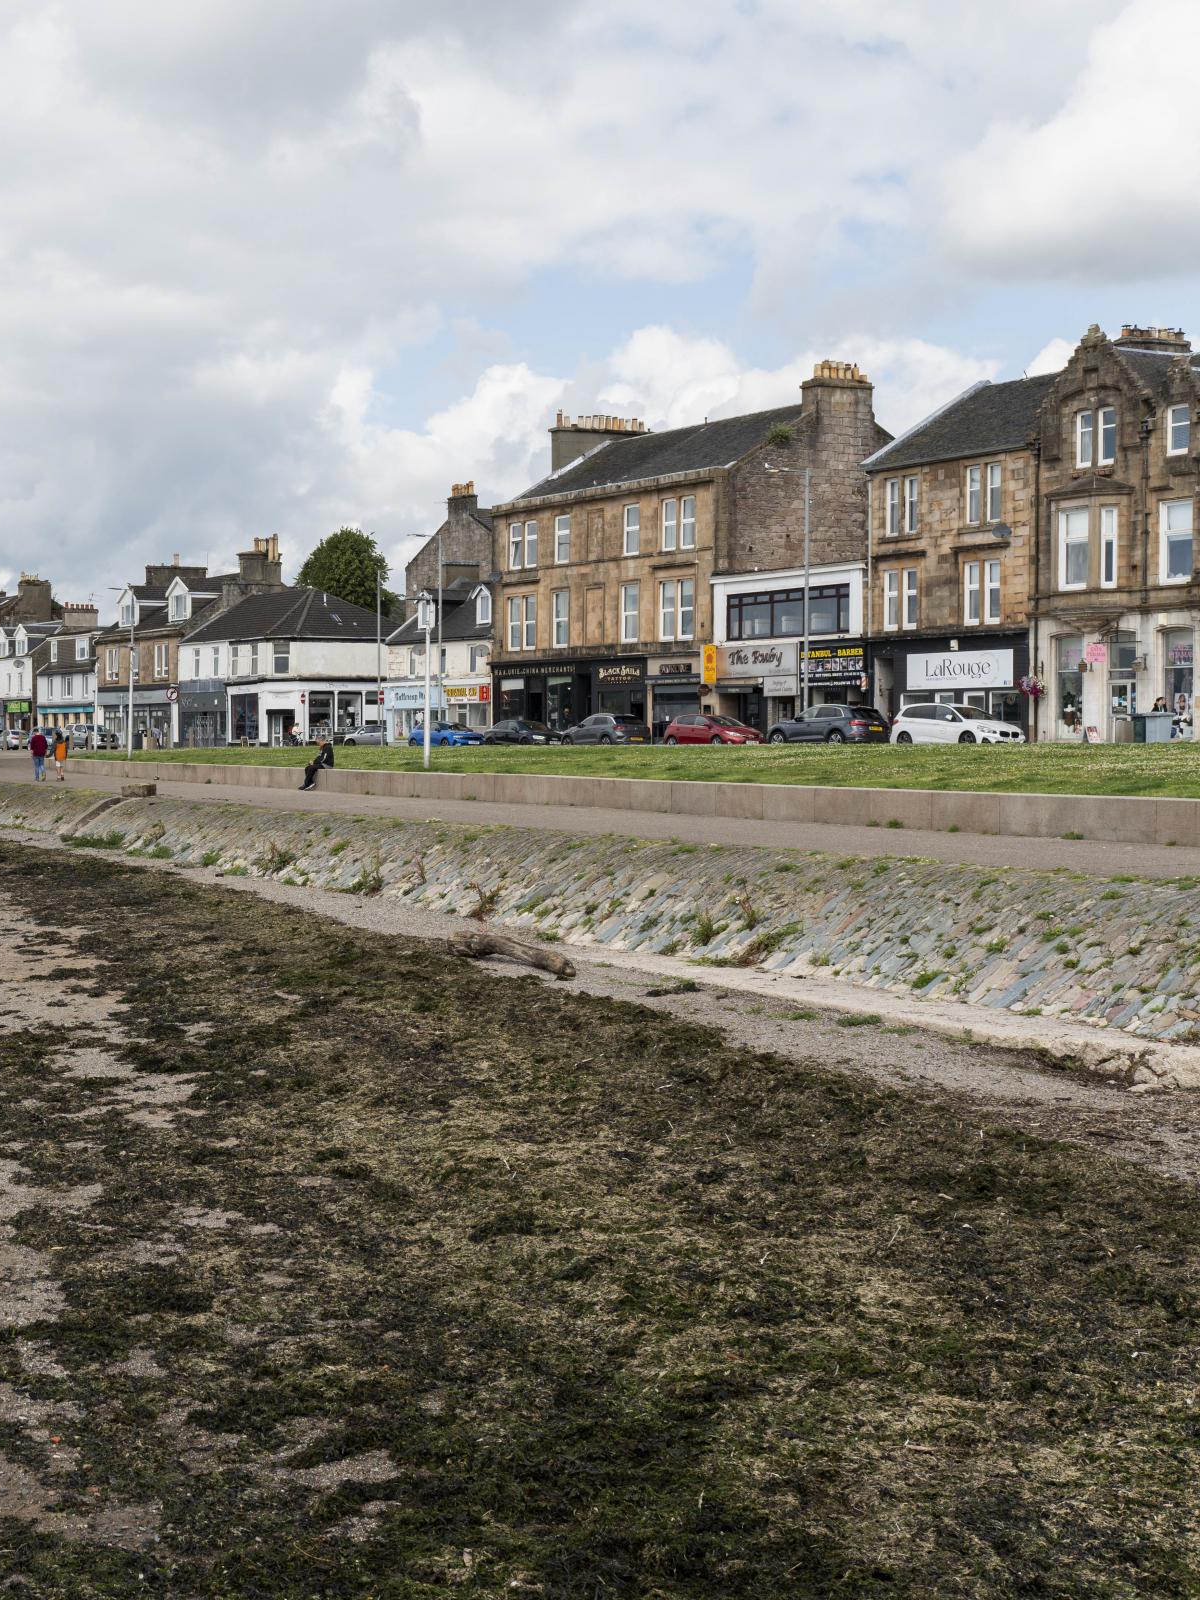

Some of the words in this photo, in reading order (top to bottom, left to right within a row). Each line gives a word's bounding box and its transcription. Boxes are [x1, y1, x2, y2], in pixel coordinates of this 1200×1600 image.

[729, 649, 749, 666] The
[752, 647, 783, 667] Ruby
[837, 648, 864, 657] BARBER
[925, 658, 991, 679] LaRouge
